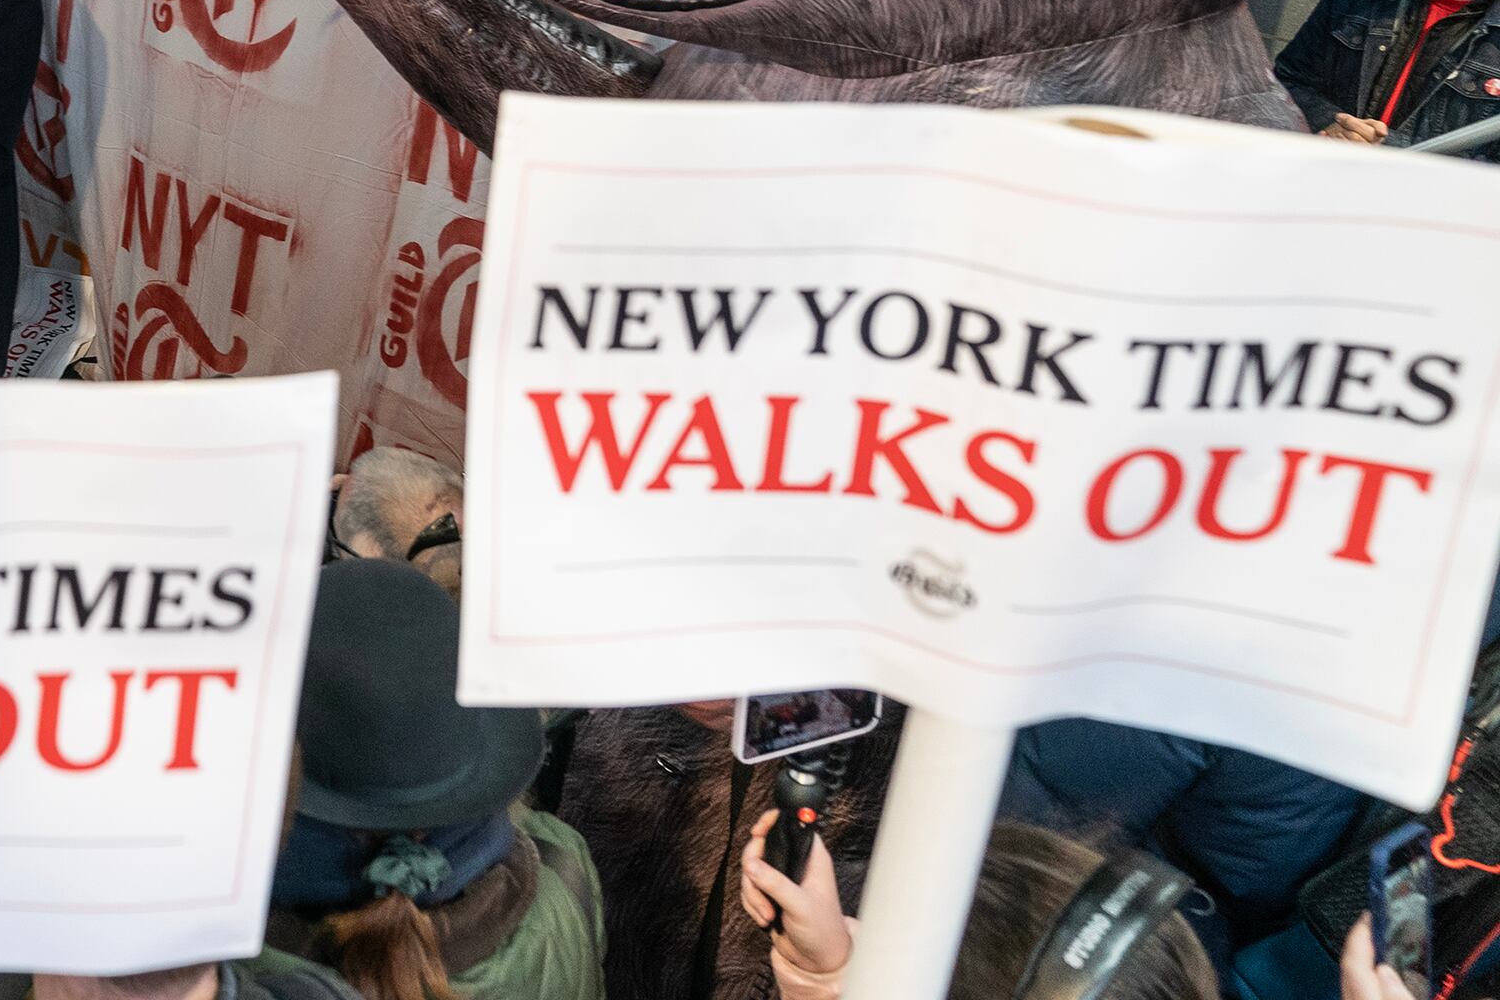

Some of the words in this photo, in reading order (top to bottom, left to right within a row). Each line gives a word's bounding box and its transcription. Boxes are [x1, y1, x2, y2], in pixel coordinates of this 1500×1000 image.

[63, 280, 77, 321] NEW
[121, 157, 291, 315] NYT
[380, 240, 426, 369] GUILD
[529, 285, 774, 354] NEW
[797, 288, 1097, 405] YORK
[1126, 338, 1461, 428] TIMES
[525, 389, 1039, 538] WALKS
[1083, 446, 1434, 567] OUT
